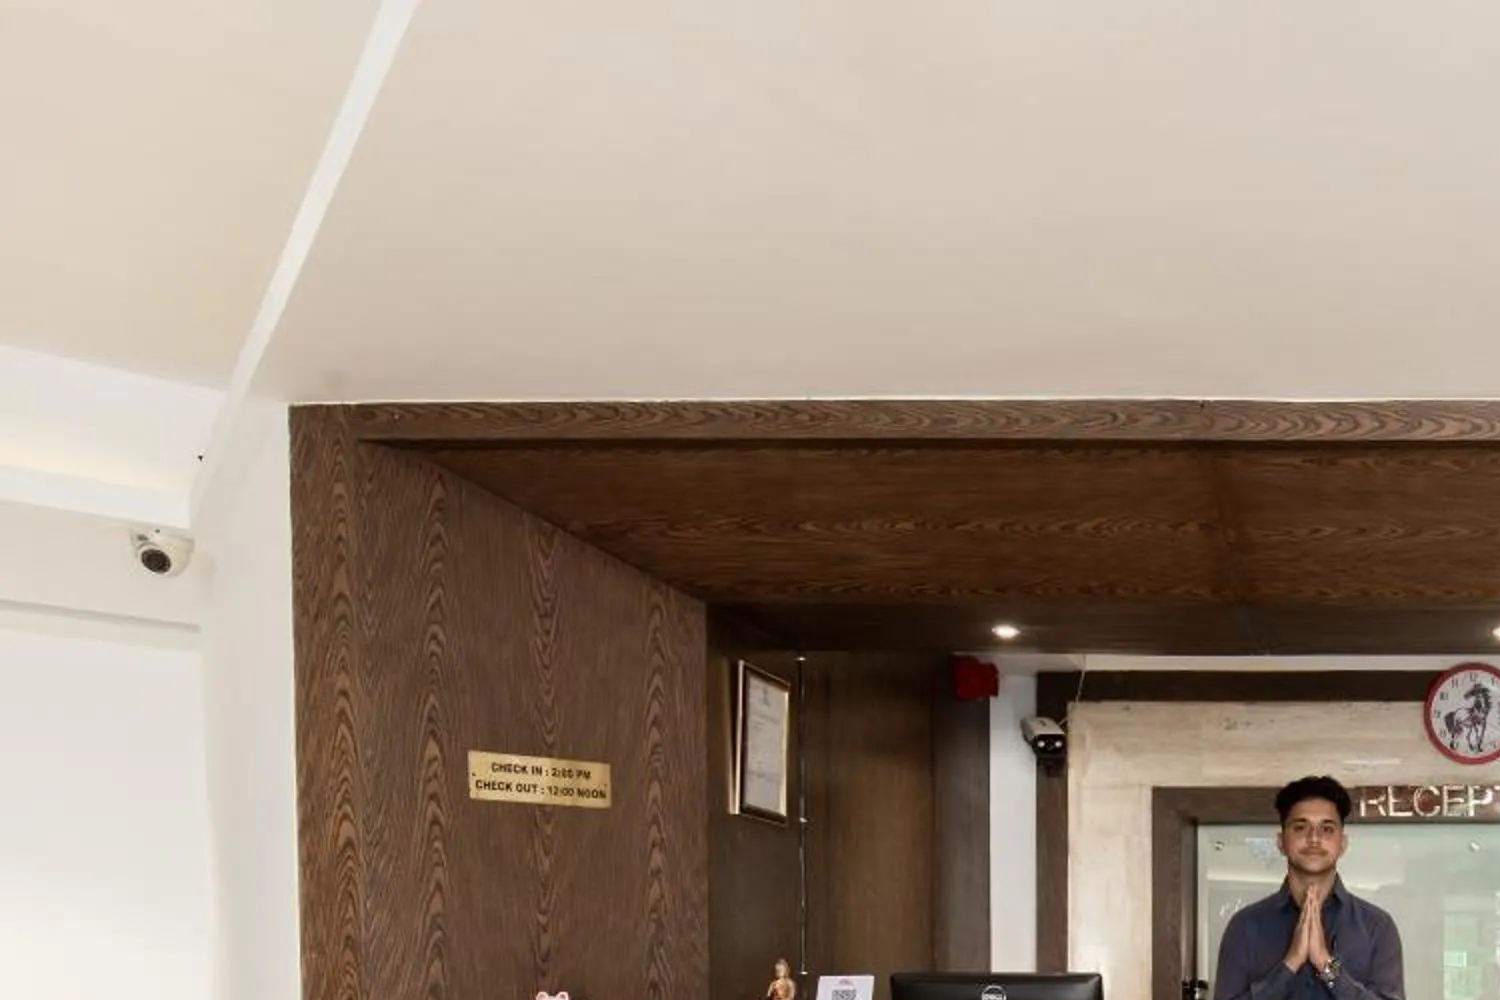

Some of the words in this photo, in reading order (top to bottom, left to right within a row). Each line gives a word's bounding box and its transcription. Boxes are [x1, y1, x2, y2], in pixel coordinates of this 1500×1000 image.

[491, 762, 528, 774] CHECK
[531, 765, 543, 776] IN
[576, 769, 591, 780] PM
[475, 780, 513, 792] CHECK
[515, 783, 537, 793] OUT
[547, 785, 575, 797] 12:00
[577, 788, 607, 799] NOON
